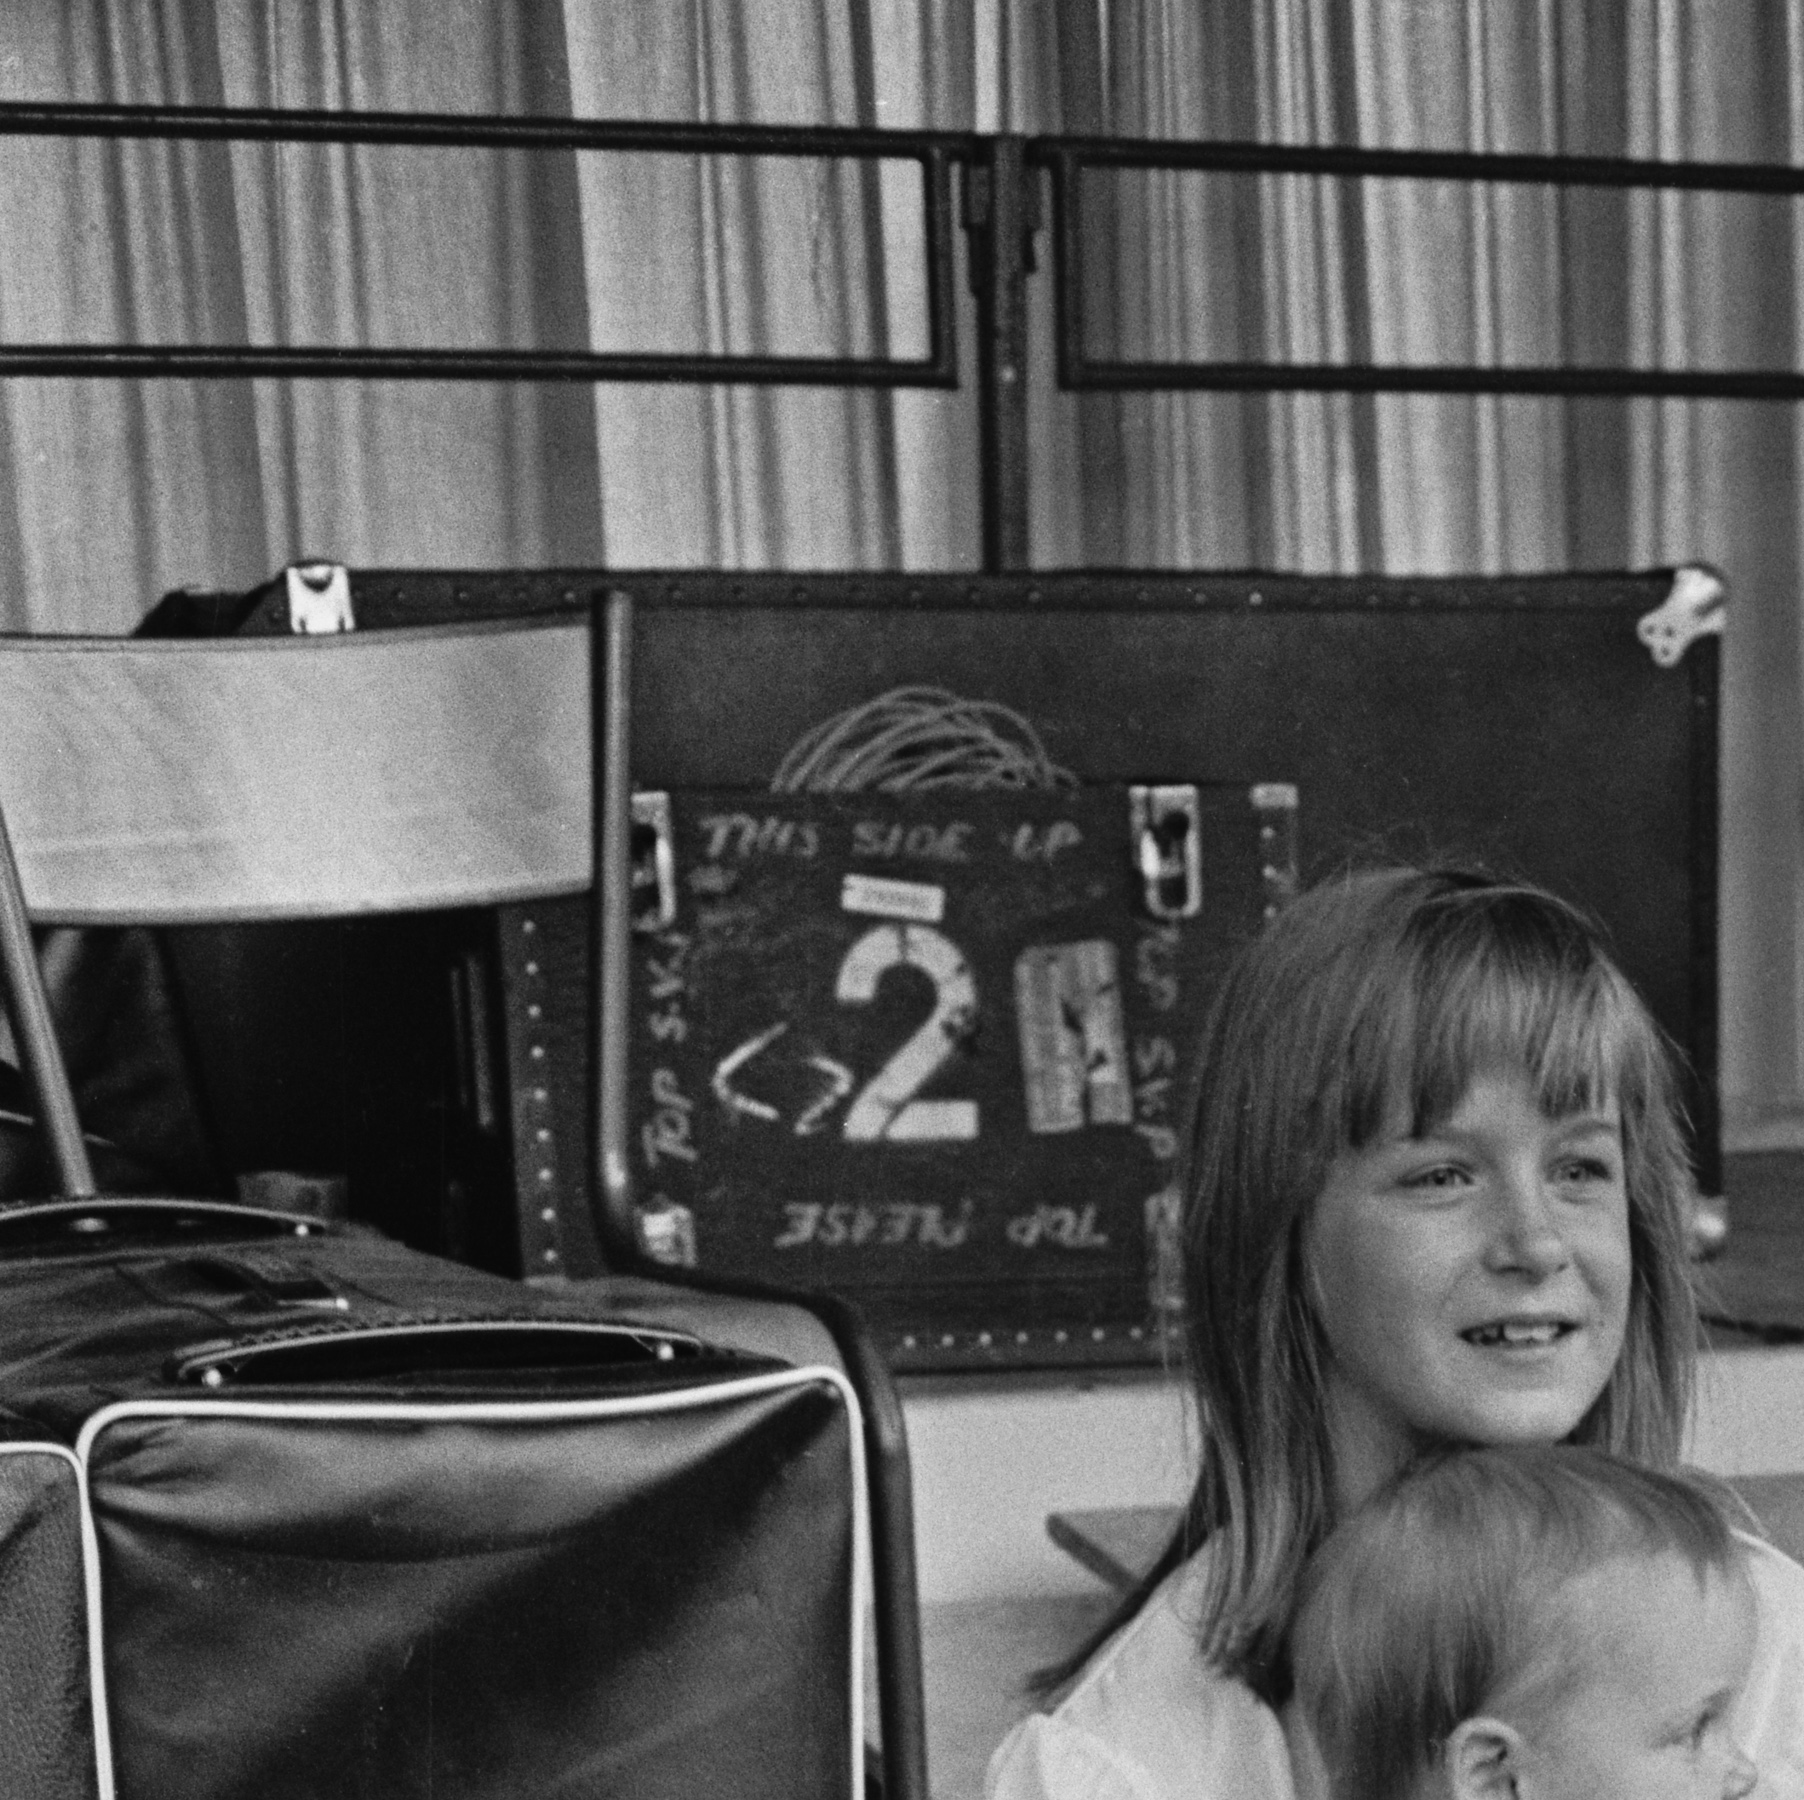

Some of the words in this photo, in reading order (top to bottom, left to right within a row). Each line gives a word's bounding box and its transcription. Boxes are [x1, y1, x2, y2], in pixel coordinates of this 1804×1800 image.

[701, 811, 820, 858] THIS
[853, 819, 976, 864] SIDE
[1011, 820, 1083, 862] UP
[836, 922, 979, 1142] 2
[643, 1067, 698, 1167] TOP
[774, 1198, 975, 1249] PLEASE
[1005, 1202, 1109, 1249] TOP
